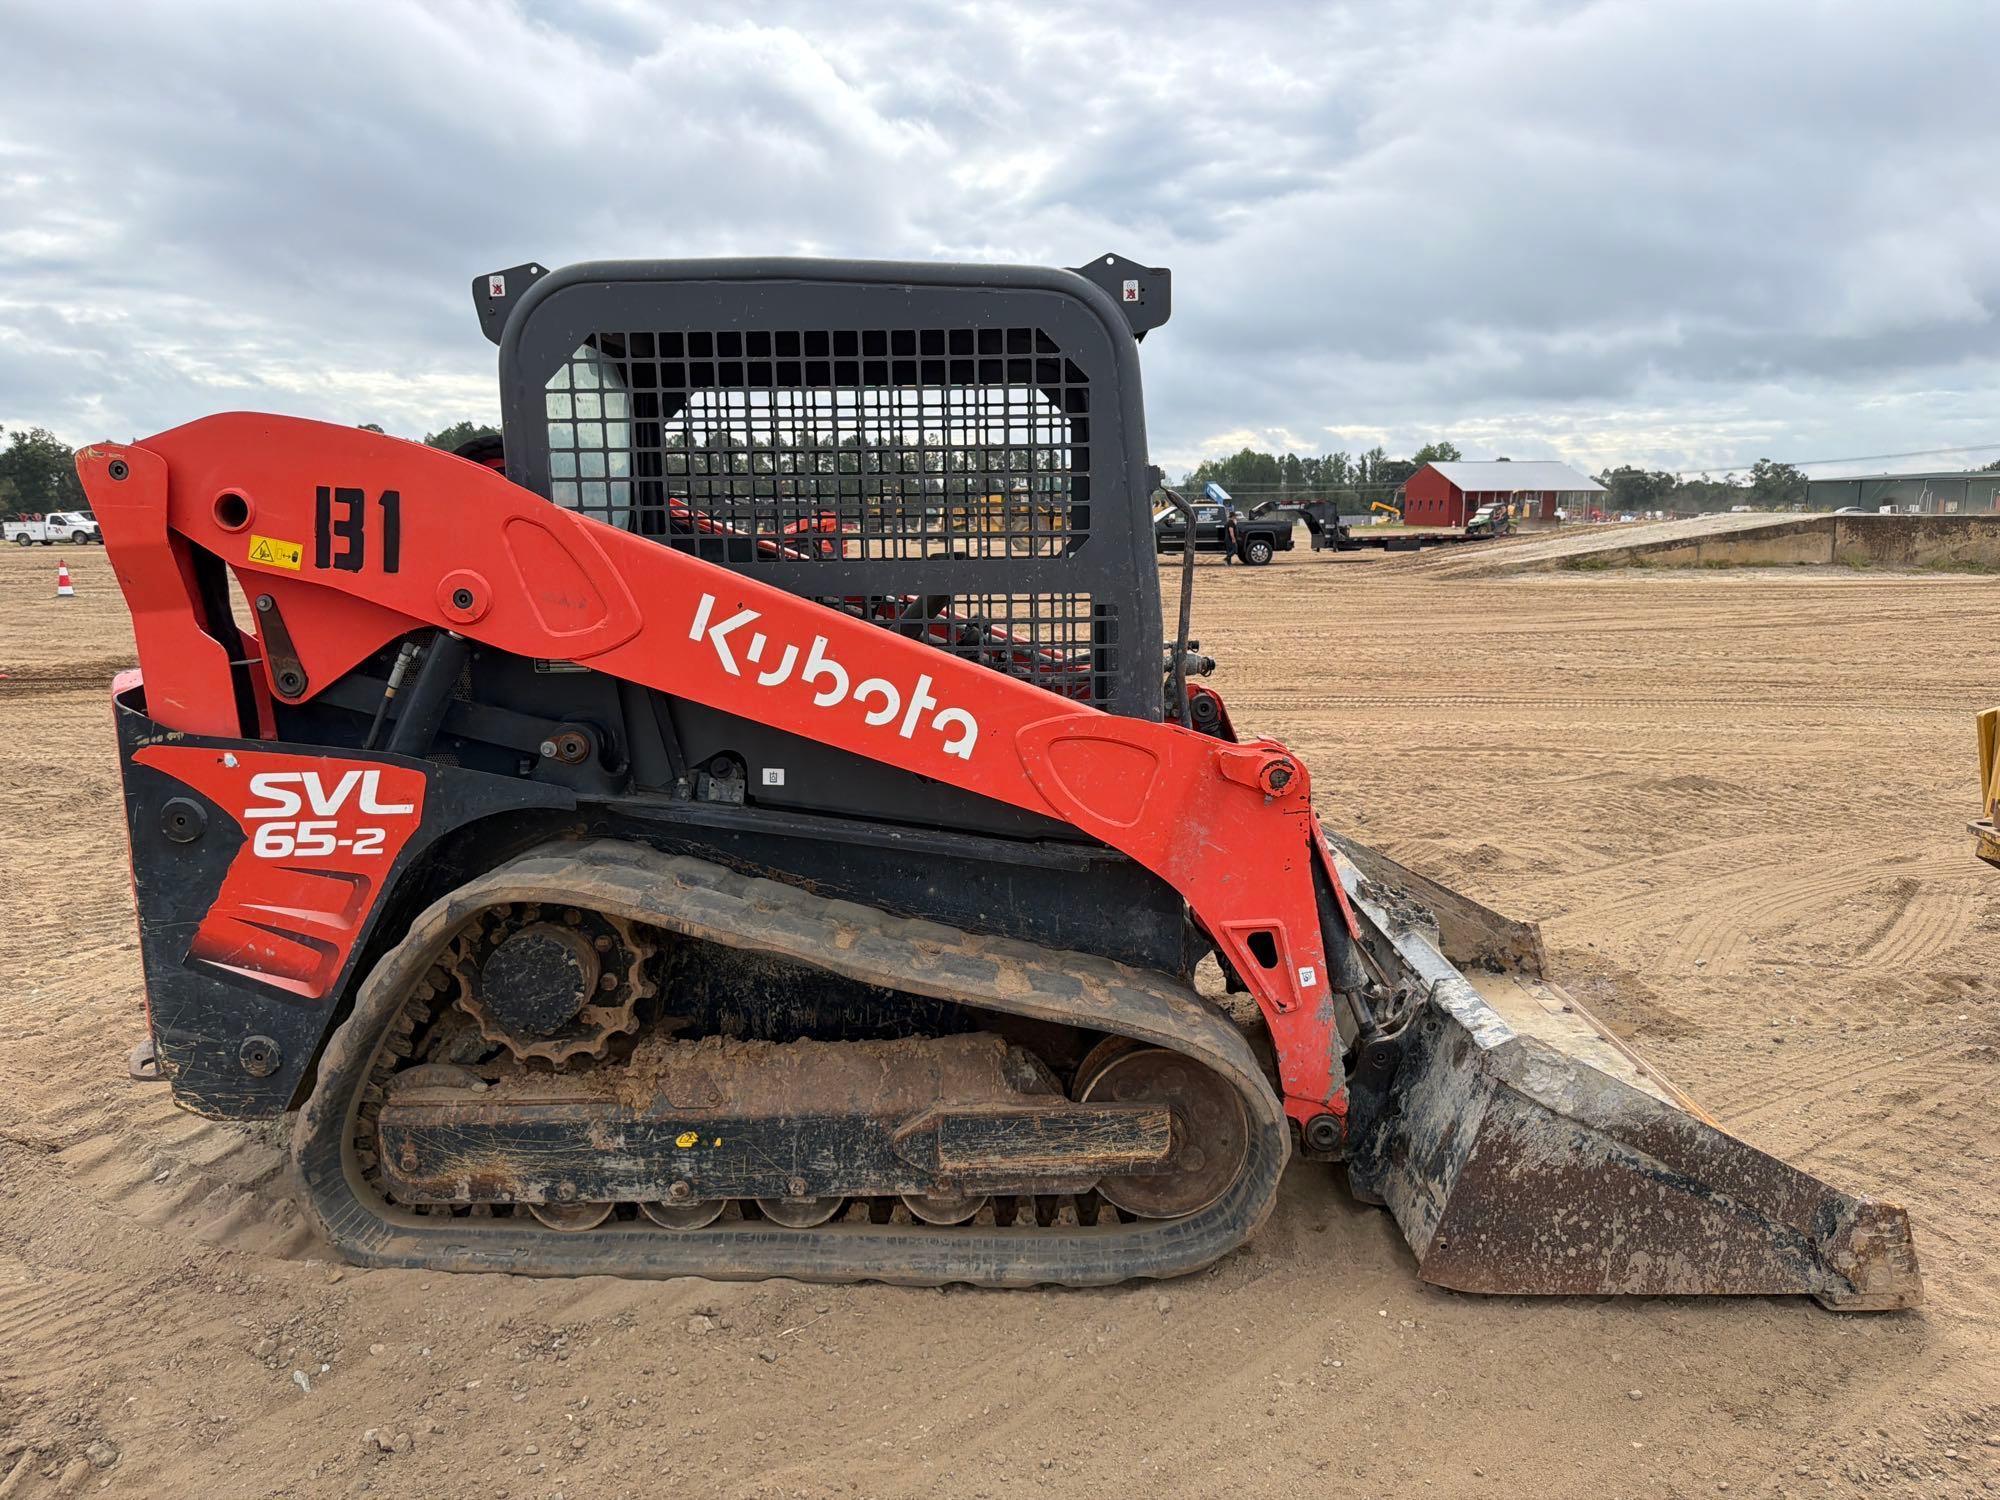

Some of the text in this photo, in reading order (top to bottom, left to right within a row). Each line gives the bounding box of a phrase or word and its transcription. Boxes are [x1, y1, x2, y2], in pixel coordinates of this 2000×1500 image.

[688, 592, 979, 760] Kubota
[243, 770, 414, 818] SVL
[253, 820, 386, 858] 65-2
